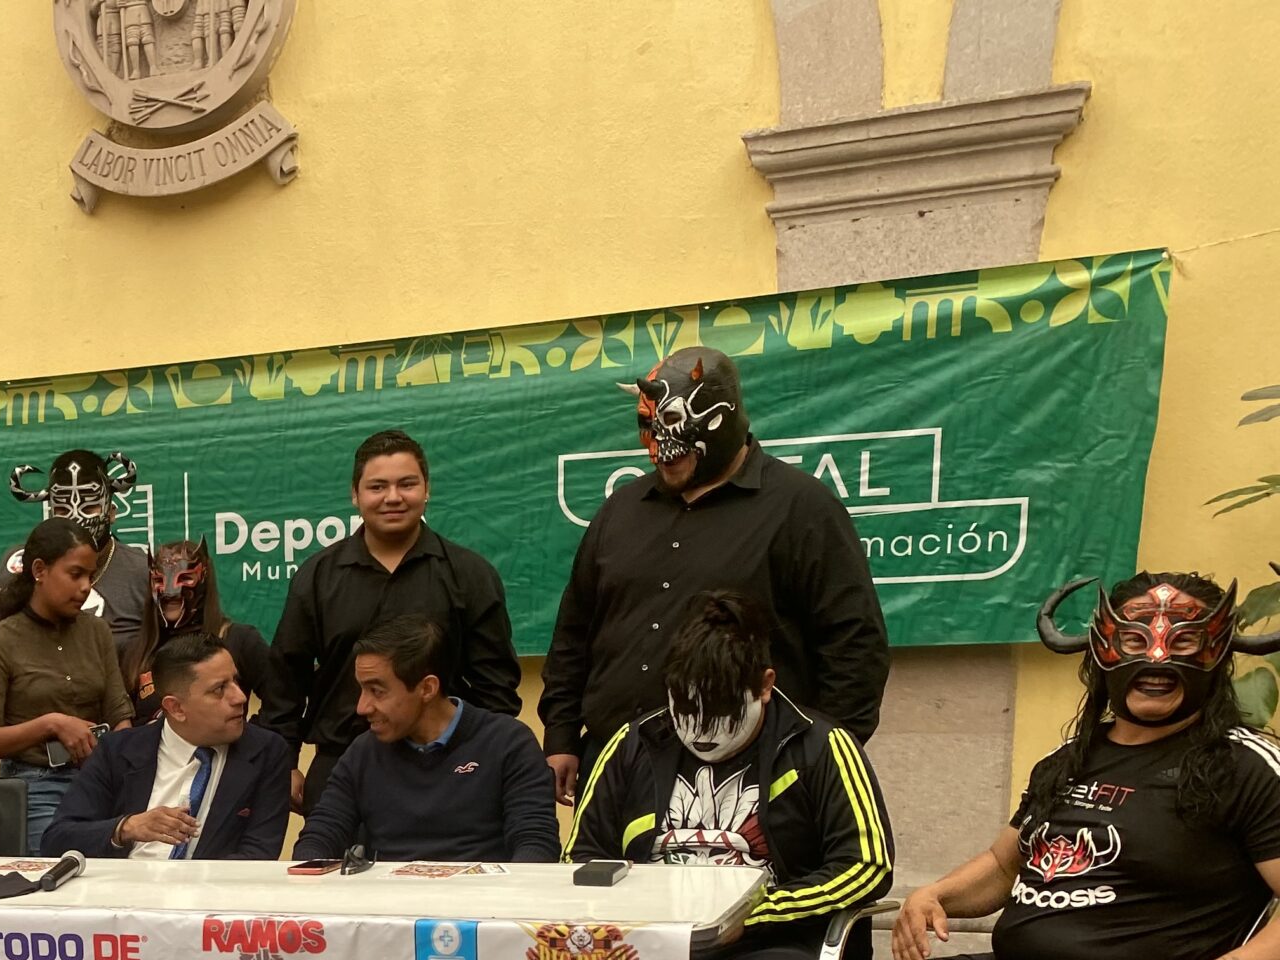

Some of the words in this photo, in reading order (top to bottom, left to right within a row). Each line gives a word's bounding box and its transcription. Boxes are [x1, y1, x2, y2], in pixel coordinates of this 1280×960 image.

[78, 139, 137, 185] LABOR
[143, 147, 207, 186] VINCIT
[213, 113, 282, 168] OMNIA
[202, 916, 327, 955] RAMOS
